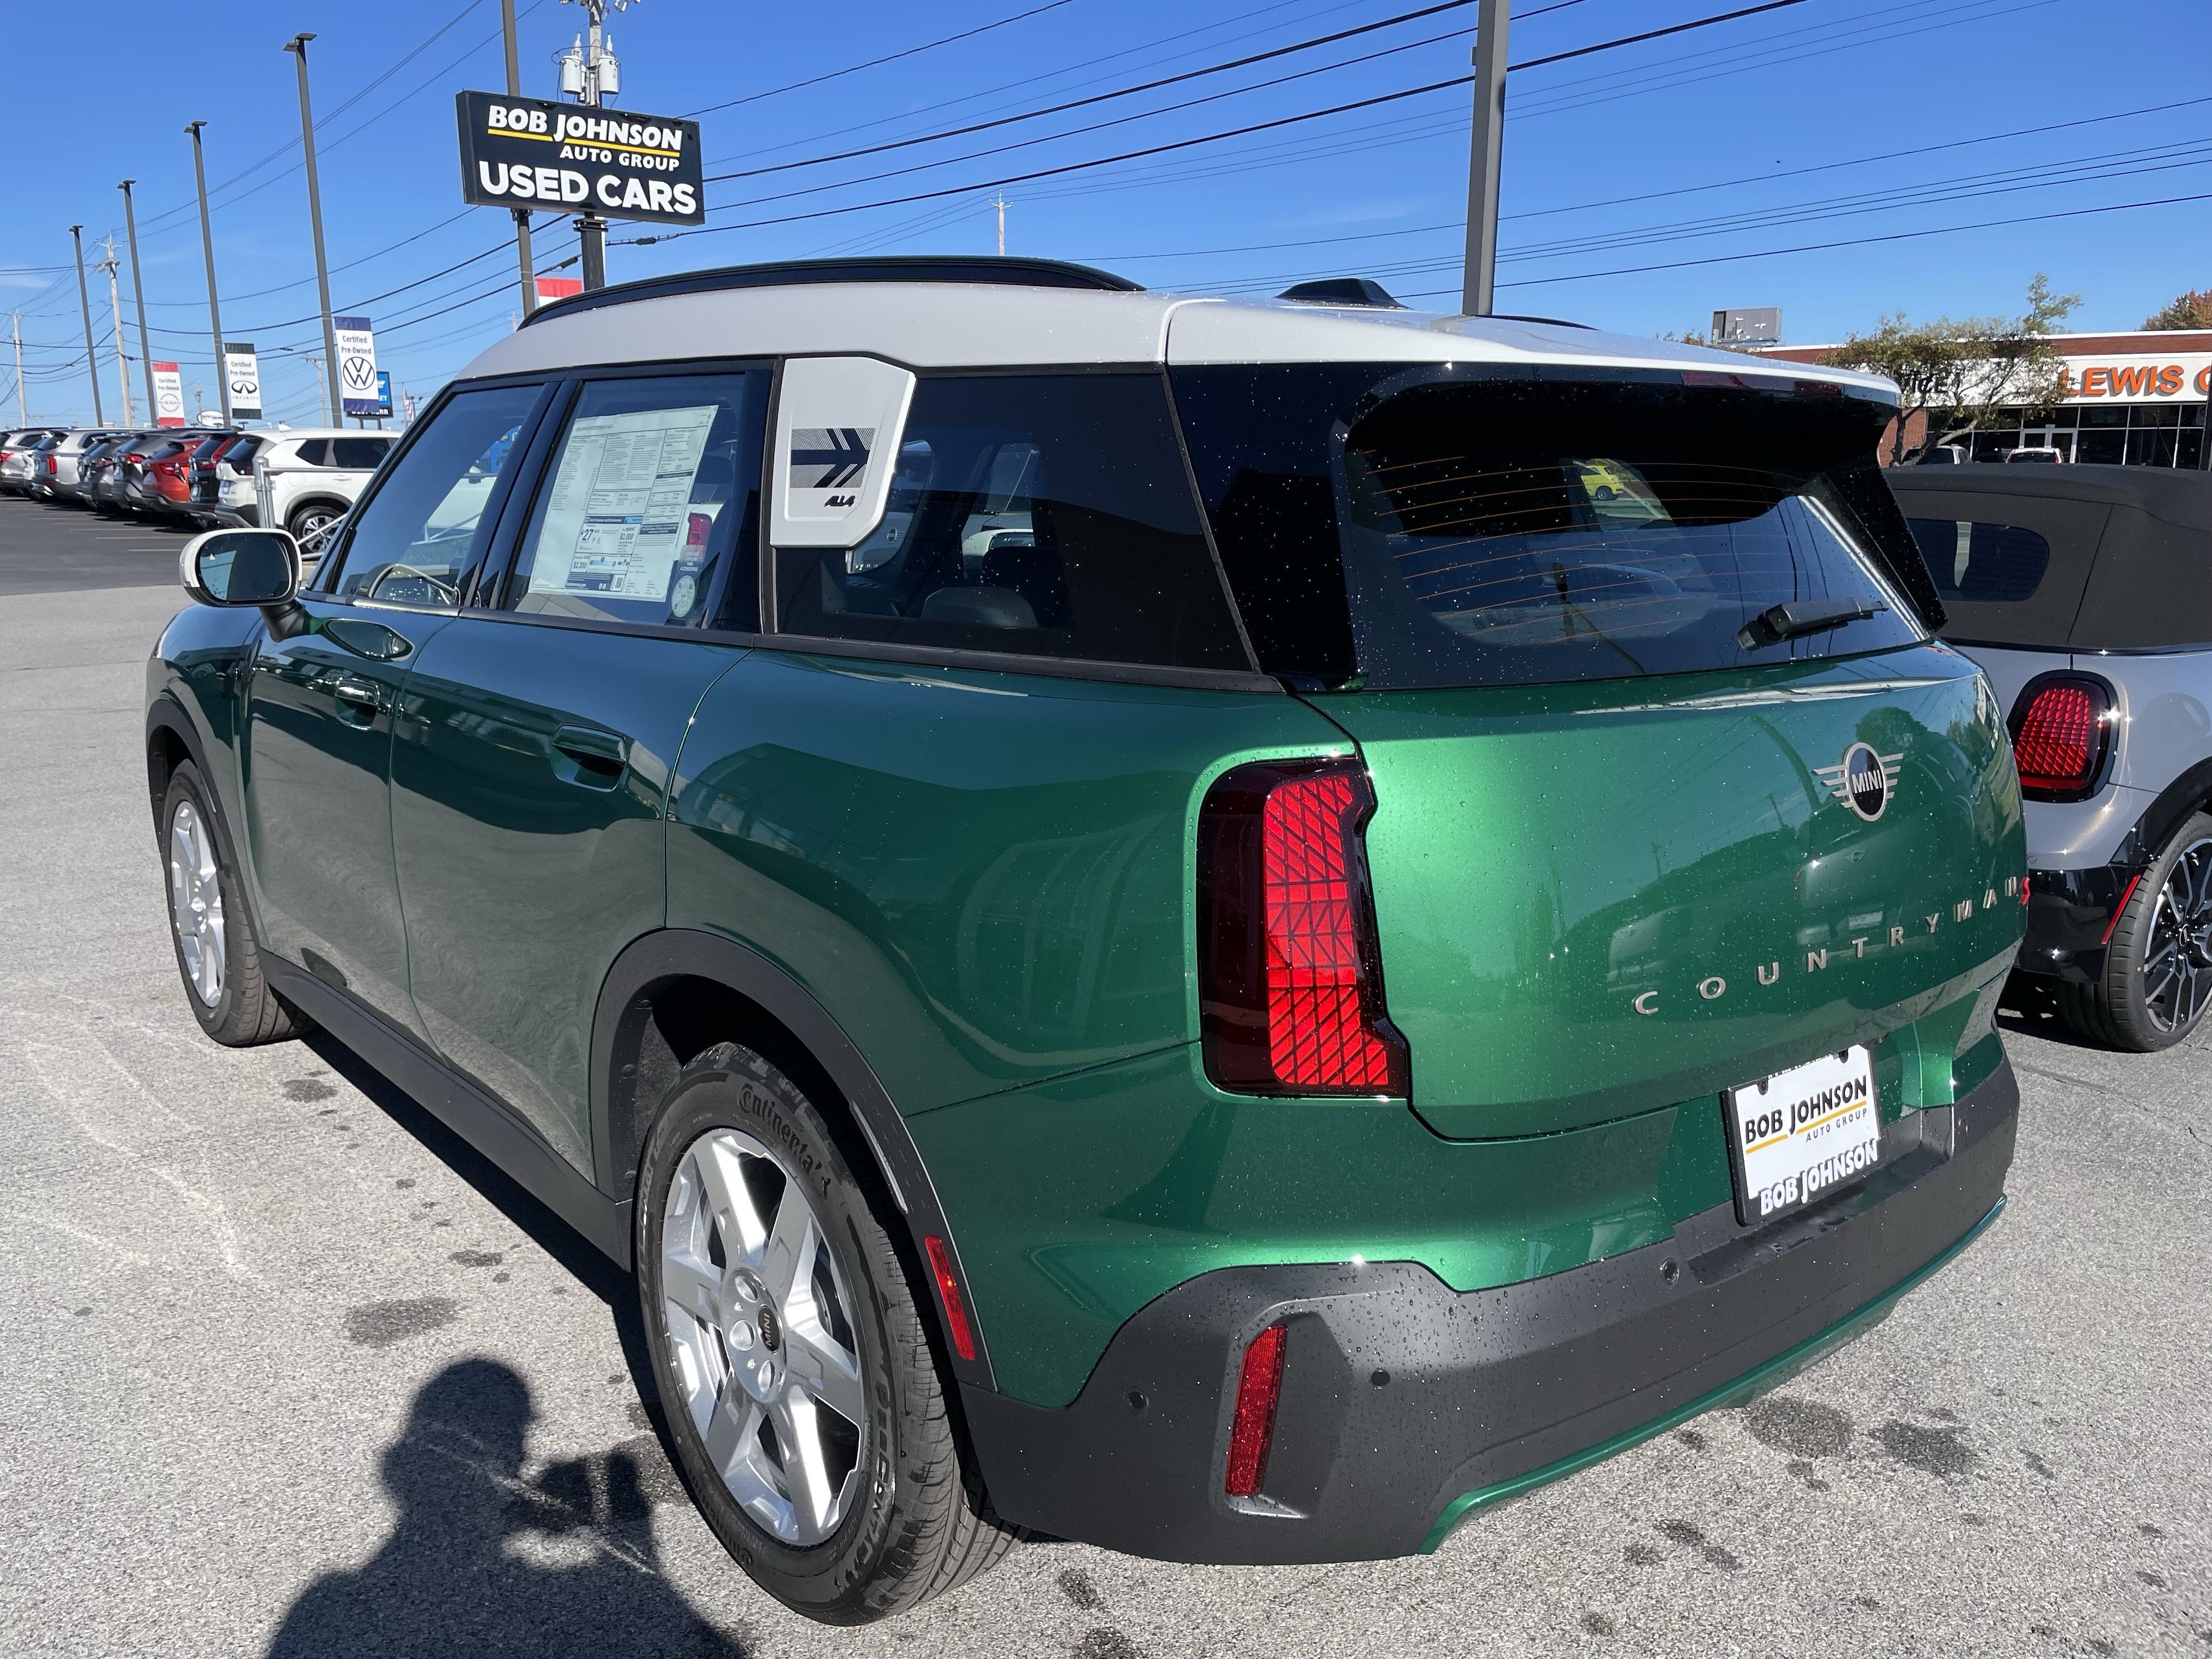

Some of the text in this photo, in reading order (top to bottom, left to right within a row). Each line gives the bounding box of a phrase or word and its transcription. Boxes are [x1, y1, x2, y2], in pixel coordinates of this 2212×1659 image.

[488, 104, 682, 151] BOB JOHNSON
[560, 145, 680, 172] AUTO GROUP
[479, 160, 697, 215] USED CARS
[341, 346, 371, 354] Pre-Owned
[342, 335, 367, 343] Certified
[2061, 365, 2185, 396] LEWIS
[582, 528, 594, 541] 27
[1852, 769, 1883, 794] MINI
[1632, 876, 2017, 1017] COUNTRYMAN
[1745, 1075, 1867, 1144] BOB JOHNSON
[1806, 1108, 1867, 1143] AUTO GROUP
[1759, 1138, 1878, 1216] BOB JOHNSON
[763, 1313, 772, 1347] MINI
